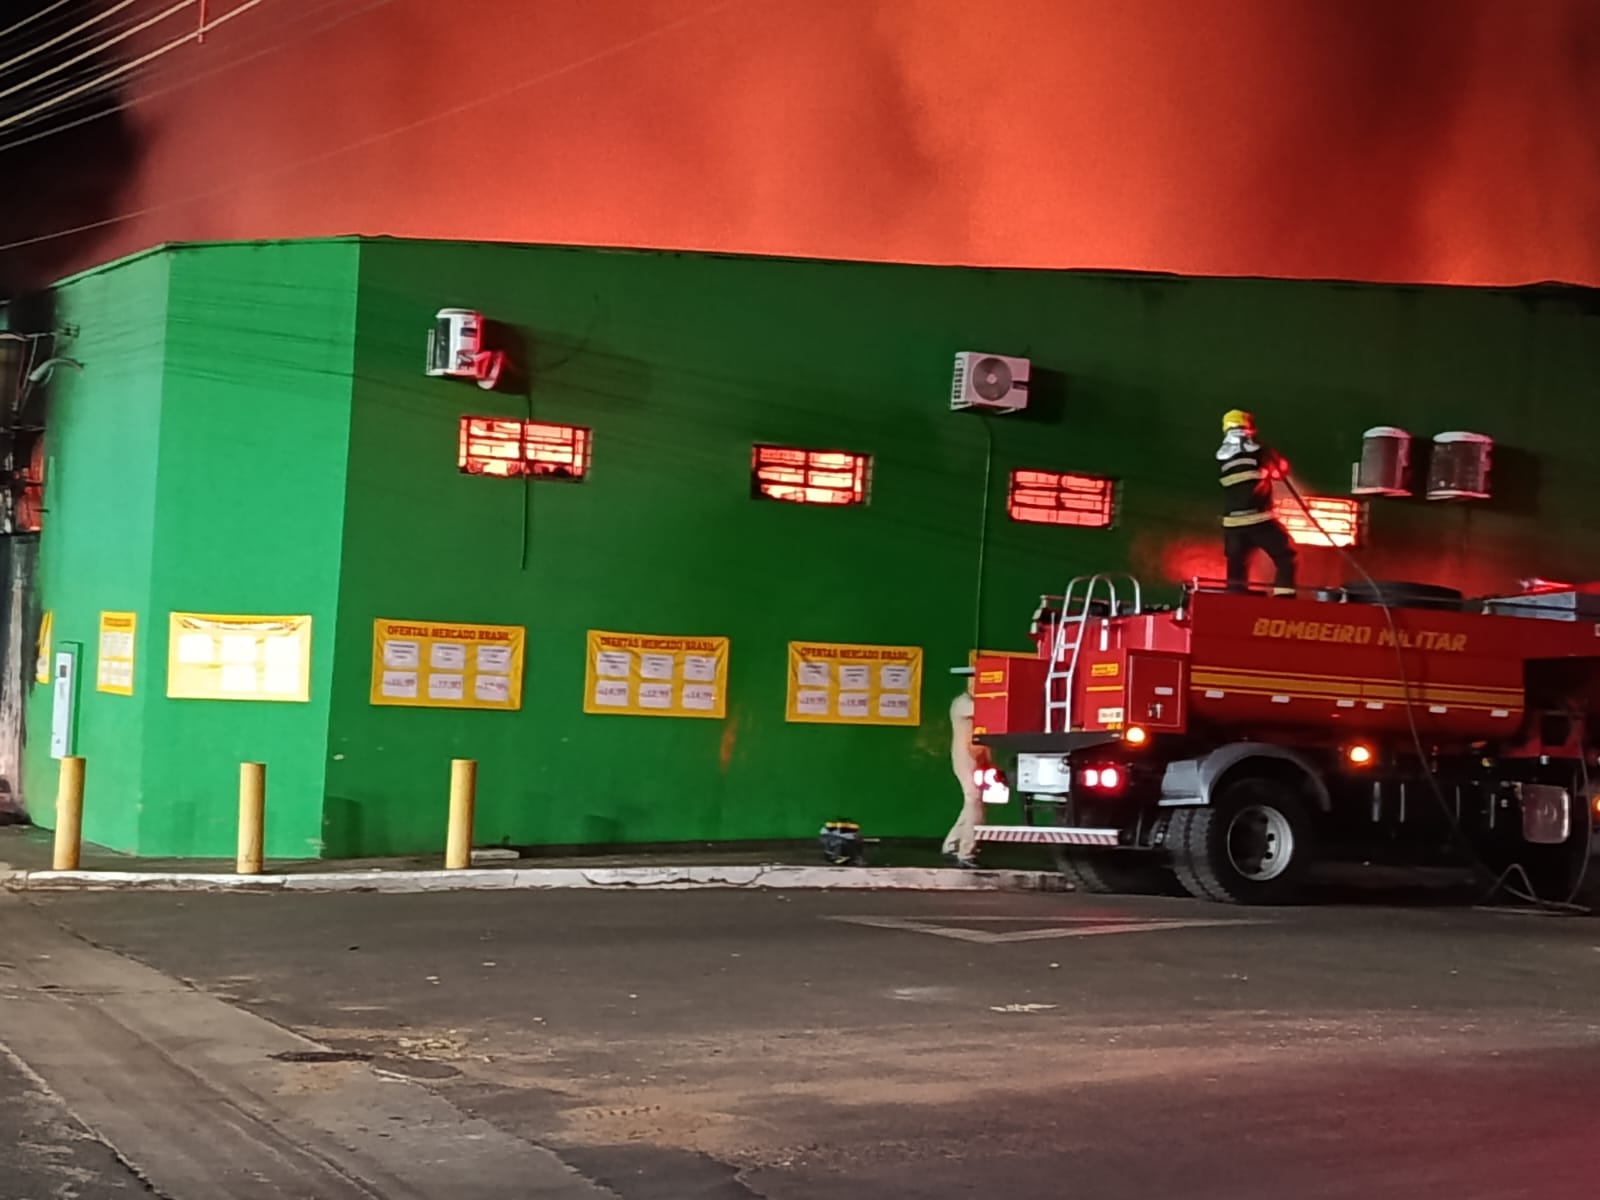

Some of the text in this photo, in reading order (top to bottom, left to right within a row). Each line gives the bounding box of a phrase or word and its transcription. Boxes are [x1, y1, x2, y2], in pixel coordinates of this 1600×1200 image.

[387, 625, 511, 641] OFERTAS MERCADO BRASIL
[1253, 618, 1371, 644] BOMBEIRO
[641, 638, 683, 650] MERCADO
[801, 647, 910, 661] OFERTAS MERCADO BRASIL
